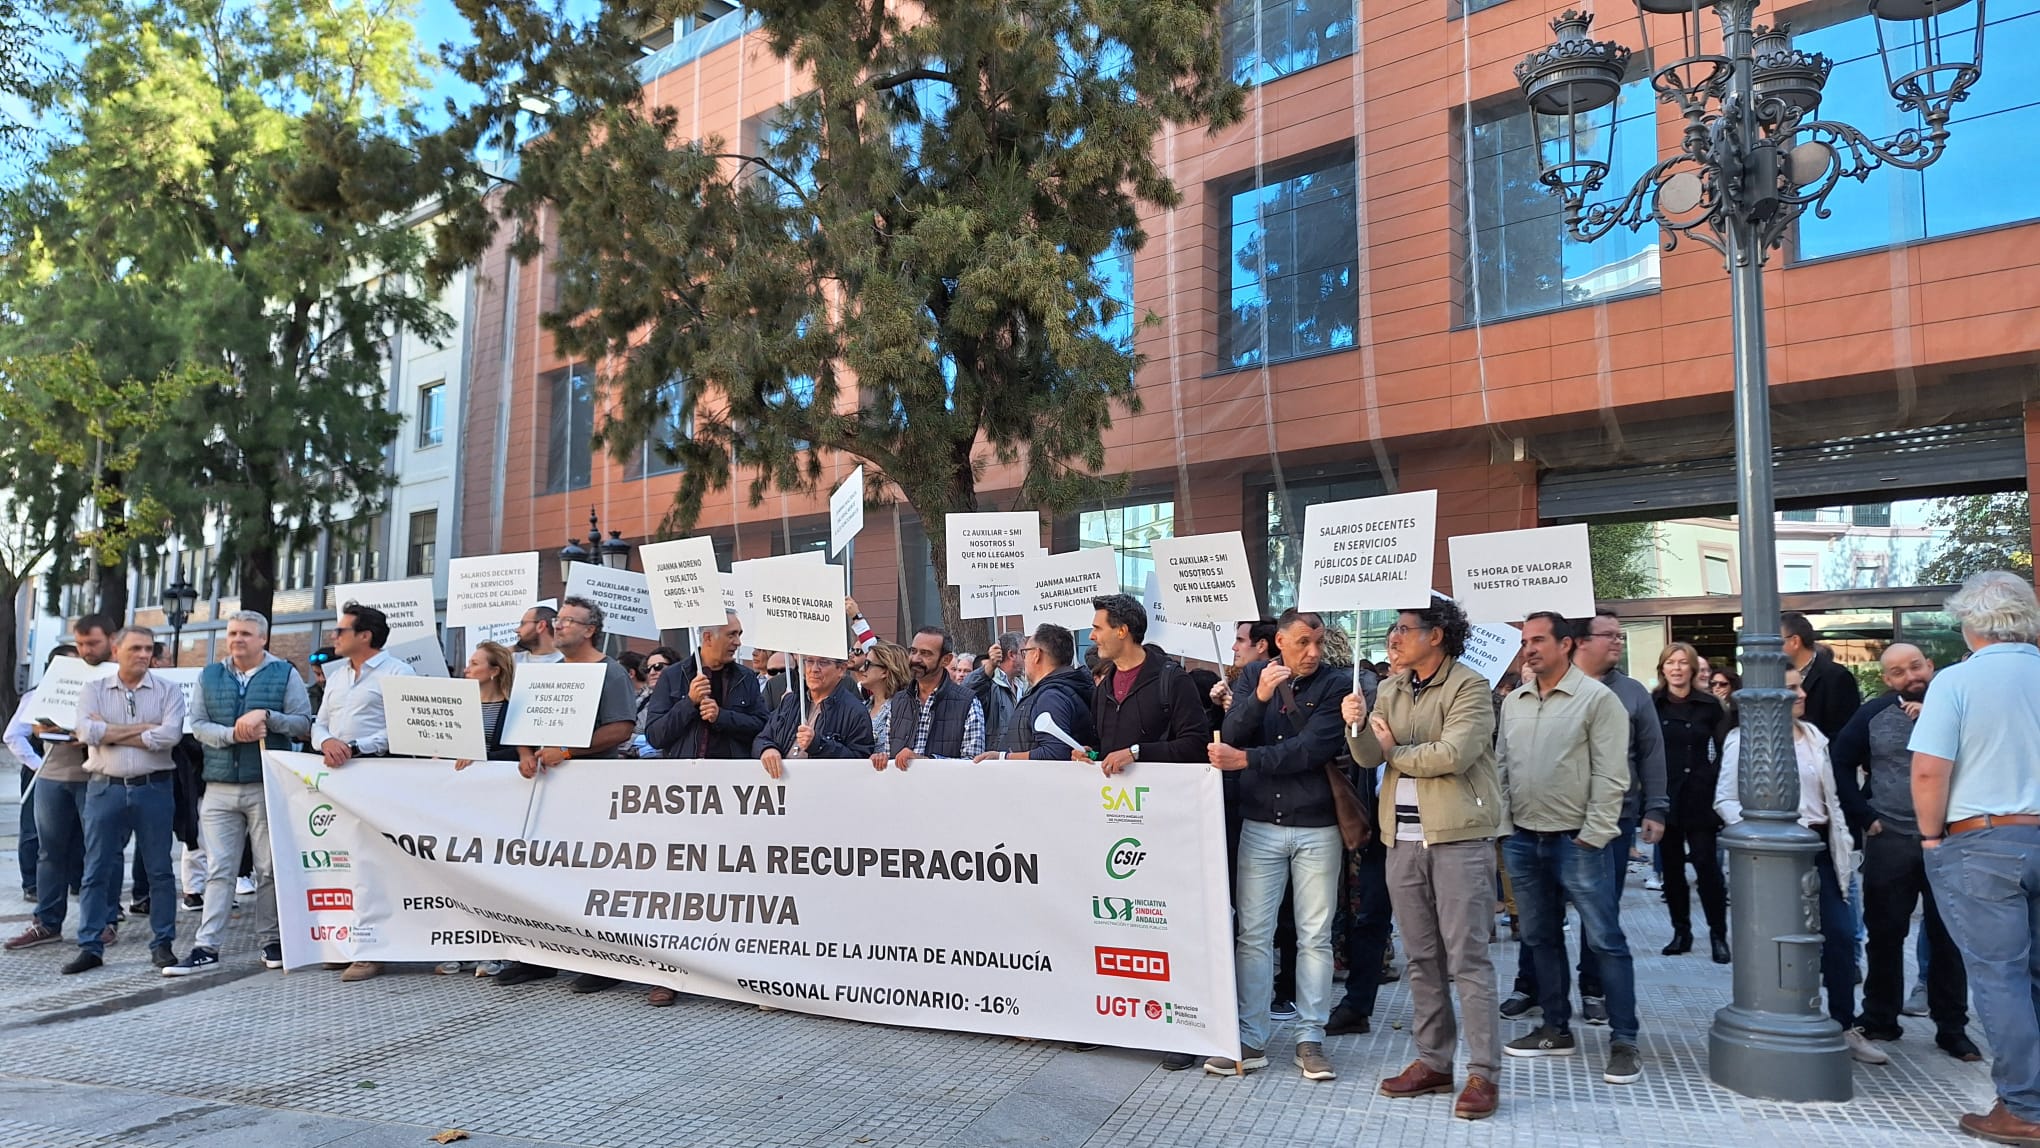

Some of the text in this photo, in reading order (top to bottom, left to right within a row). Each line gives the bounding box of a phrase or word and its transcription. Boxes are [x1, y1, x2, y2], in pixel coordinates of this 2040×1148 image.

[1320, 518, 1416, 536] SALARIOS DECENTES
[970, 540, 1007, 548] NOSOTROS
[1333, 536, 1398, 552] EN SERVICIOS
[962, 552, 976, 560] QUE
[988, 550, 1025, 558] LLEGAMOS
[1170, 554, 1228, 566] C2 AUXILIAR SMI
[1314, 552, 1418, 570] PÚBLICOS DE CALIDAD
[656, 558, 702, 572] JUANMA MORENO
[1467, 561, 1572, 578] ES HORA DE VALORAR
[460, 568, 526, 580] SALARIOS DECENTES
[666, 573, 698, 584] Y SUS ALTOS
[1179, 567, 1224, 578] NOSOTROS SI
[480, 578, 514, 588] SERVICIOS
[1036, 572, 1101, 589] JUANMA MALTRATA
[1320, 570, 1408, 588] ¡SUBIDA SALARIAL!
[1473, 575, 1568, 590] NUESTRO TRABAJO
[596, 580, 630, 592] AUXILIAR
[664, 588, 687, 598] CARGOS:
[692, 586, 699, 594] 18
[1040, 584, 1098, 600] SALARIALMENTE
[1173, 580, 1236, 593] QUE NO LLEGAMOS
[456, 588, 528, 600] PÚBLICOS DE CALIDAD
[592, 590, 641, 604] NOSOTROS SI
[1185, 596, 1190, 604] A
[1214, 594, 1228, 602] MES
[382, 600, 418, 610] MALTRATA
[598, 600, 609, 608] NO
[610, 602, 648, 614] LLEGAMOS
[674, 598, 684, 608] TÚ:
[687, 600, 694, 608] 16
[762, 594, 833, 608] ES HORA DE VALORAR
[1038, 603, 1053, 611] SUS
[1153, 602, 1162, 610] ES
[609, 612, 618, 620] DE
[620, 614, 636, 622] MES
[766, 608, 830, 622] NUESTRO TRABAJO
[1464, 643, 1498, 663] CALIDAD
[1461, 653, 1487, 668] ARIAL!
[528, 682, 586, 690] JUANMA MORENO
[401, 694, 462, 706] JUANMA MORENO
[534, 694, 574, 702] Y SUS ALTOS
[416, 707, 431, 716] SUS
[432, 708, 454, 717] ALTOS
[526, 706, 555, 714] CARGOS:
[560, 706, 569, 714] 18
[406, 718, 462, 730] CARGOS: 18 %
[533, 717, 564, 727] TÚ: 16 %
[418, 730, 452, 740] TÚ: 16 %
[609, 784, 786, 820] ¡BASTA YA!
[446, 836, 483, 864] LA
[494, 838, 657, 870] IGUALDAD
[666, 843, 707, 872] EN
[718, 844, 756, 873] LA
[767, 842, 1039, 884] RECUPERACIÓN
[1114, 850, 1146, 866] CSIF
[584, 889, 800, 926] RETRIBUTIVA
[1134, 898, 1166, 908] INICIATIVA
[1135, 907, 1164, 916] SINDICAL
[1136, 916, 1168, 924] ANDALUZA
[403, 896, 1052, 972] PERSONAL FUNCIONARIO DE LA ADMINISTRACIÓN GENERAL DE LA JUNTA DE ANDALUCÍA
[431, 930, 526, 946] PRESIDENTE
[526, 938, 536, 948] Y
[538, 940, 577, 956] ALTOS
[577, 948, 645, 967] CARGOS:
[1100, 952, 1164, 974] CCOO
[737, 978, 1020, 1016] PERSONAL FUNCIONARIO: -16%
[1096, 995, 1141, 1018] UGT
